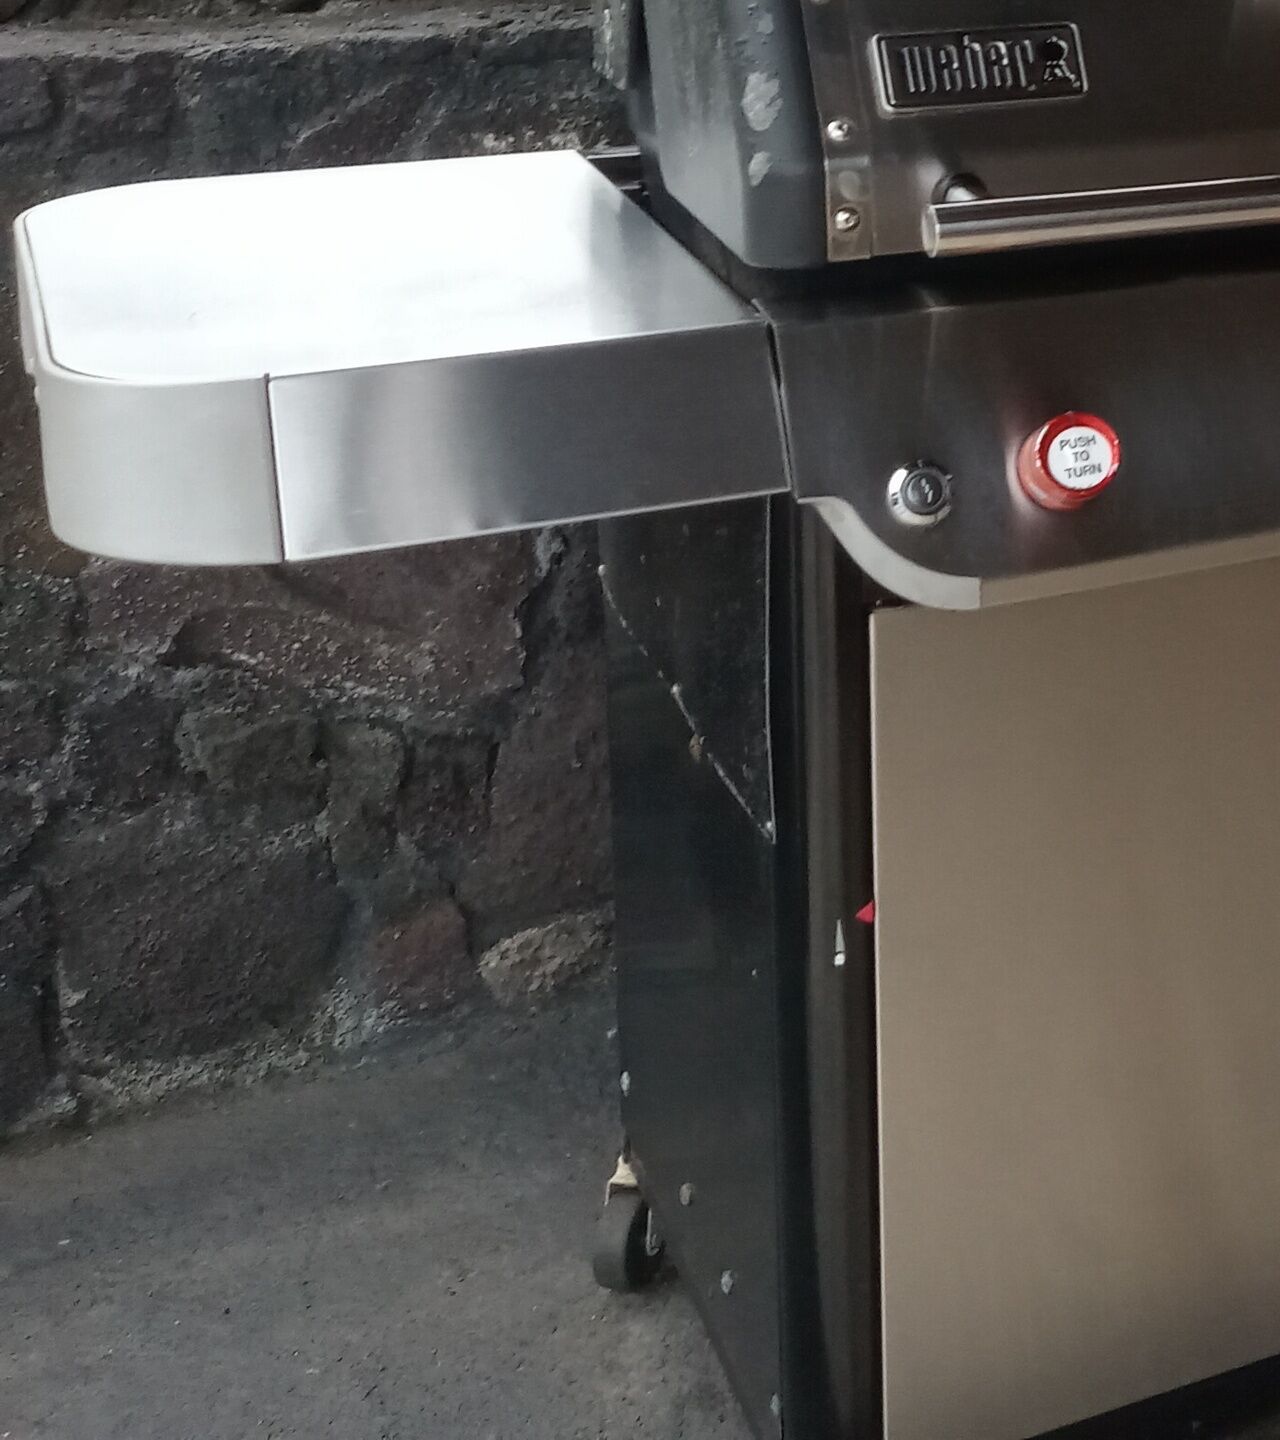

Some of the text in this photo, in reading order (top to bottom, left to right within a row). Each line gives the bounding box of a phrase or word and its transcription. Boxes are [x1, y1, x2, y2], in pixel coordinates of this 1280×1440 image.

[1059, 435, 1097, 451] PUSH
[1072, 450, 1090, 463] TO
[1064, 463, 1102, 479] TURN
